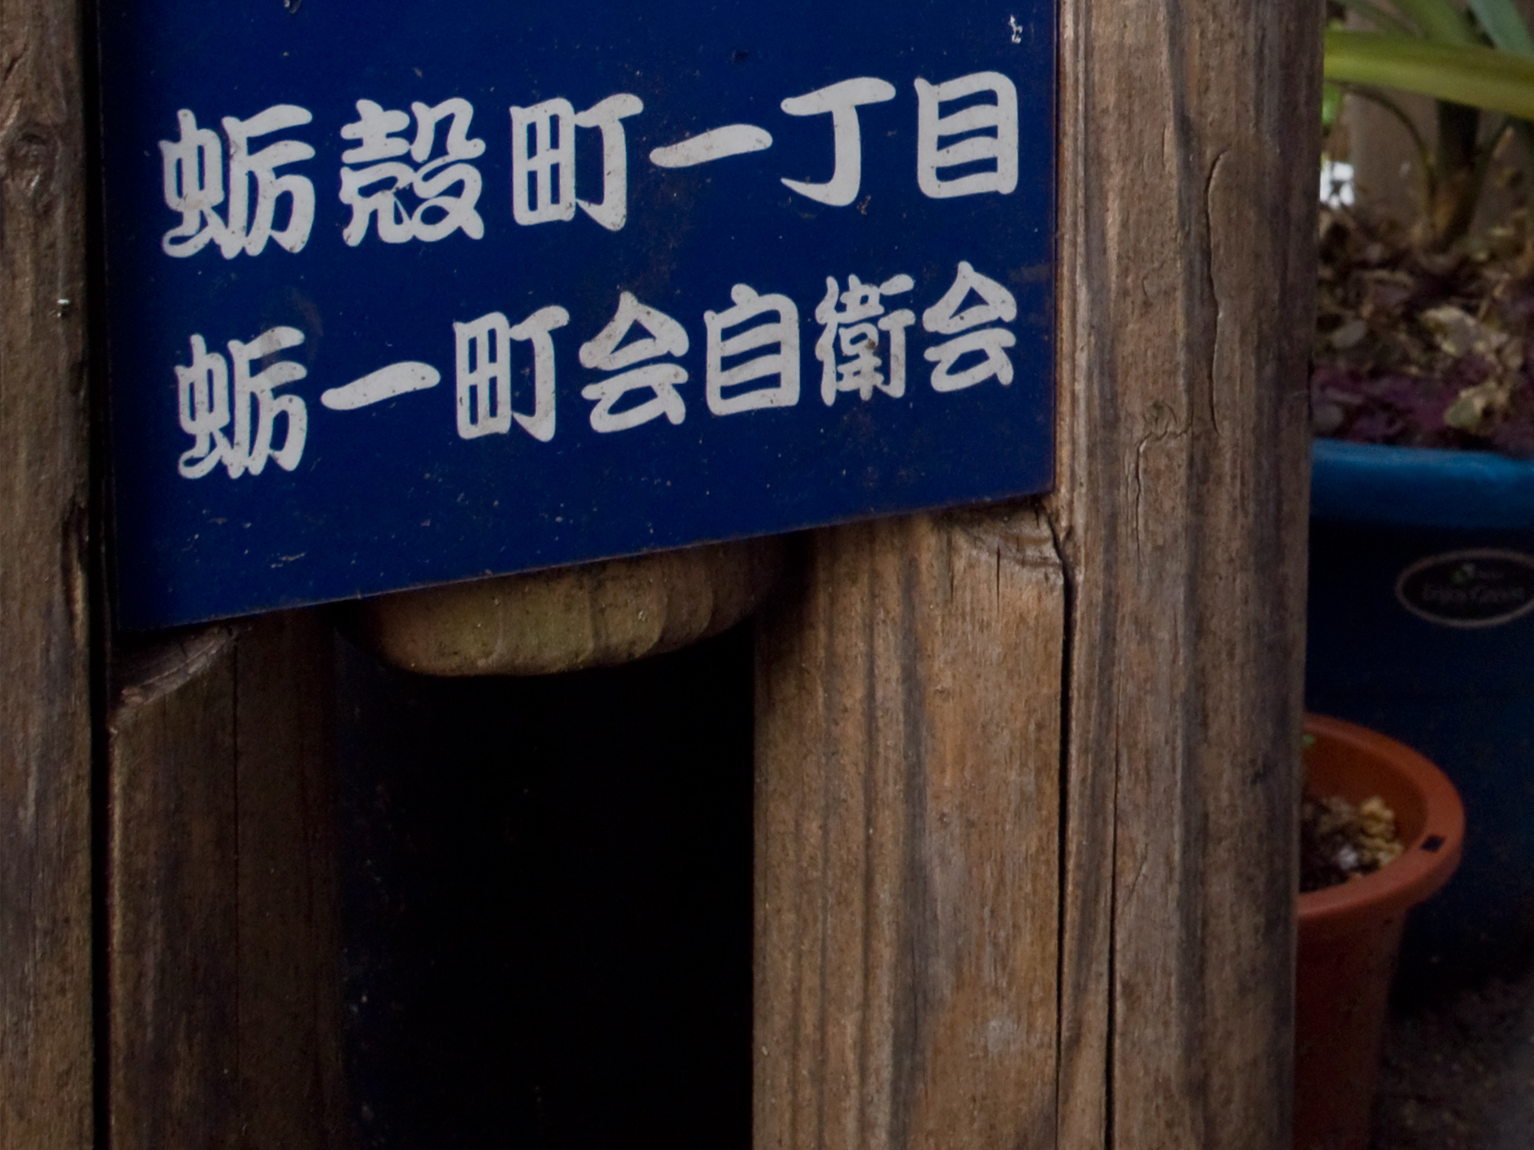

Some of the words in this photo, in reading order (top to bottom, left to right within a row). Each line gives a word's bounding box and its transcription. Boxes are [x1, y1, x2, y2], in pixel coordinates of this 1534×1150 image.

[157, 69, 1020, 261] 蛎殻町一丁目
[173, 259, 1019, 481] 蛎一町会自衛会
